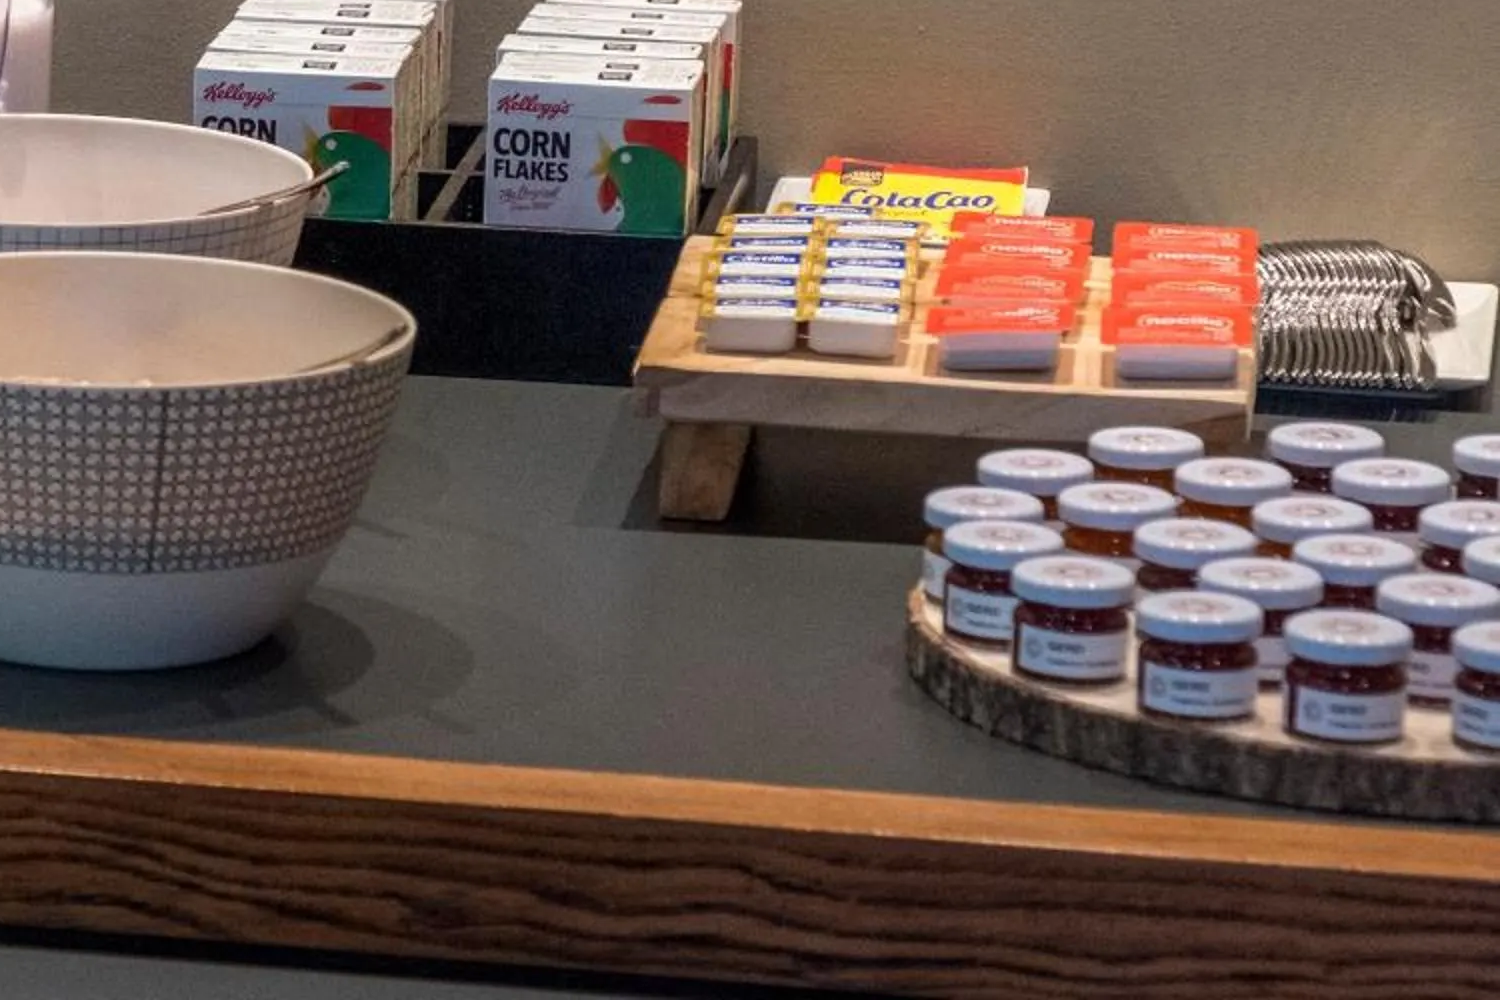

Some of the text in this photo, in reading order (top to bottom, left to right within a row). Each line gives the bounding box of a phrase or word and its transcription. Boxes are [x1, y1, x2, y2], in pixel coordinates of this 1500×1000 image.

[202, 81, 277, 108] Kellogg's
[497, 93, 573, 120] Kellogg's
[493, 127, 571, 159] CORN
[493, 158, 569, 183] FLAKES
[840, 188, 995, 210] ColaCao
